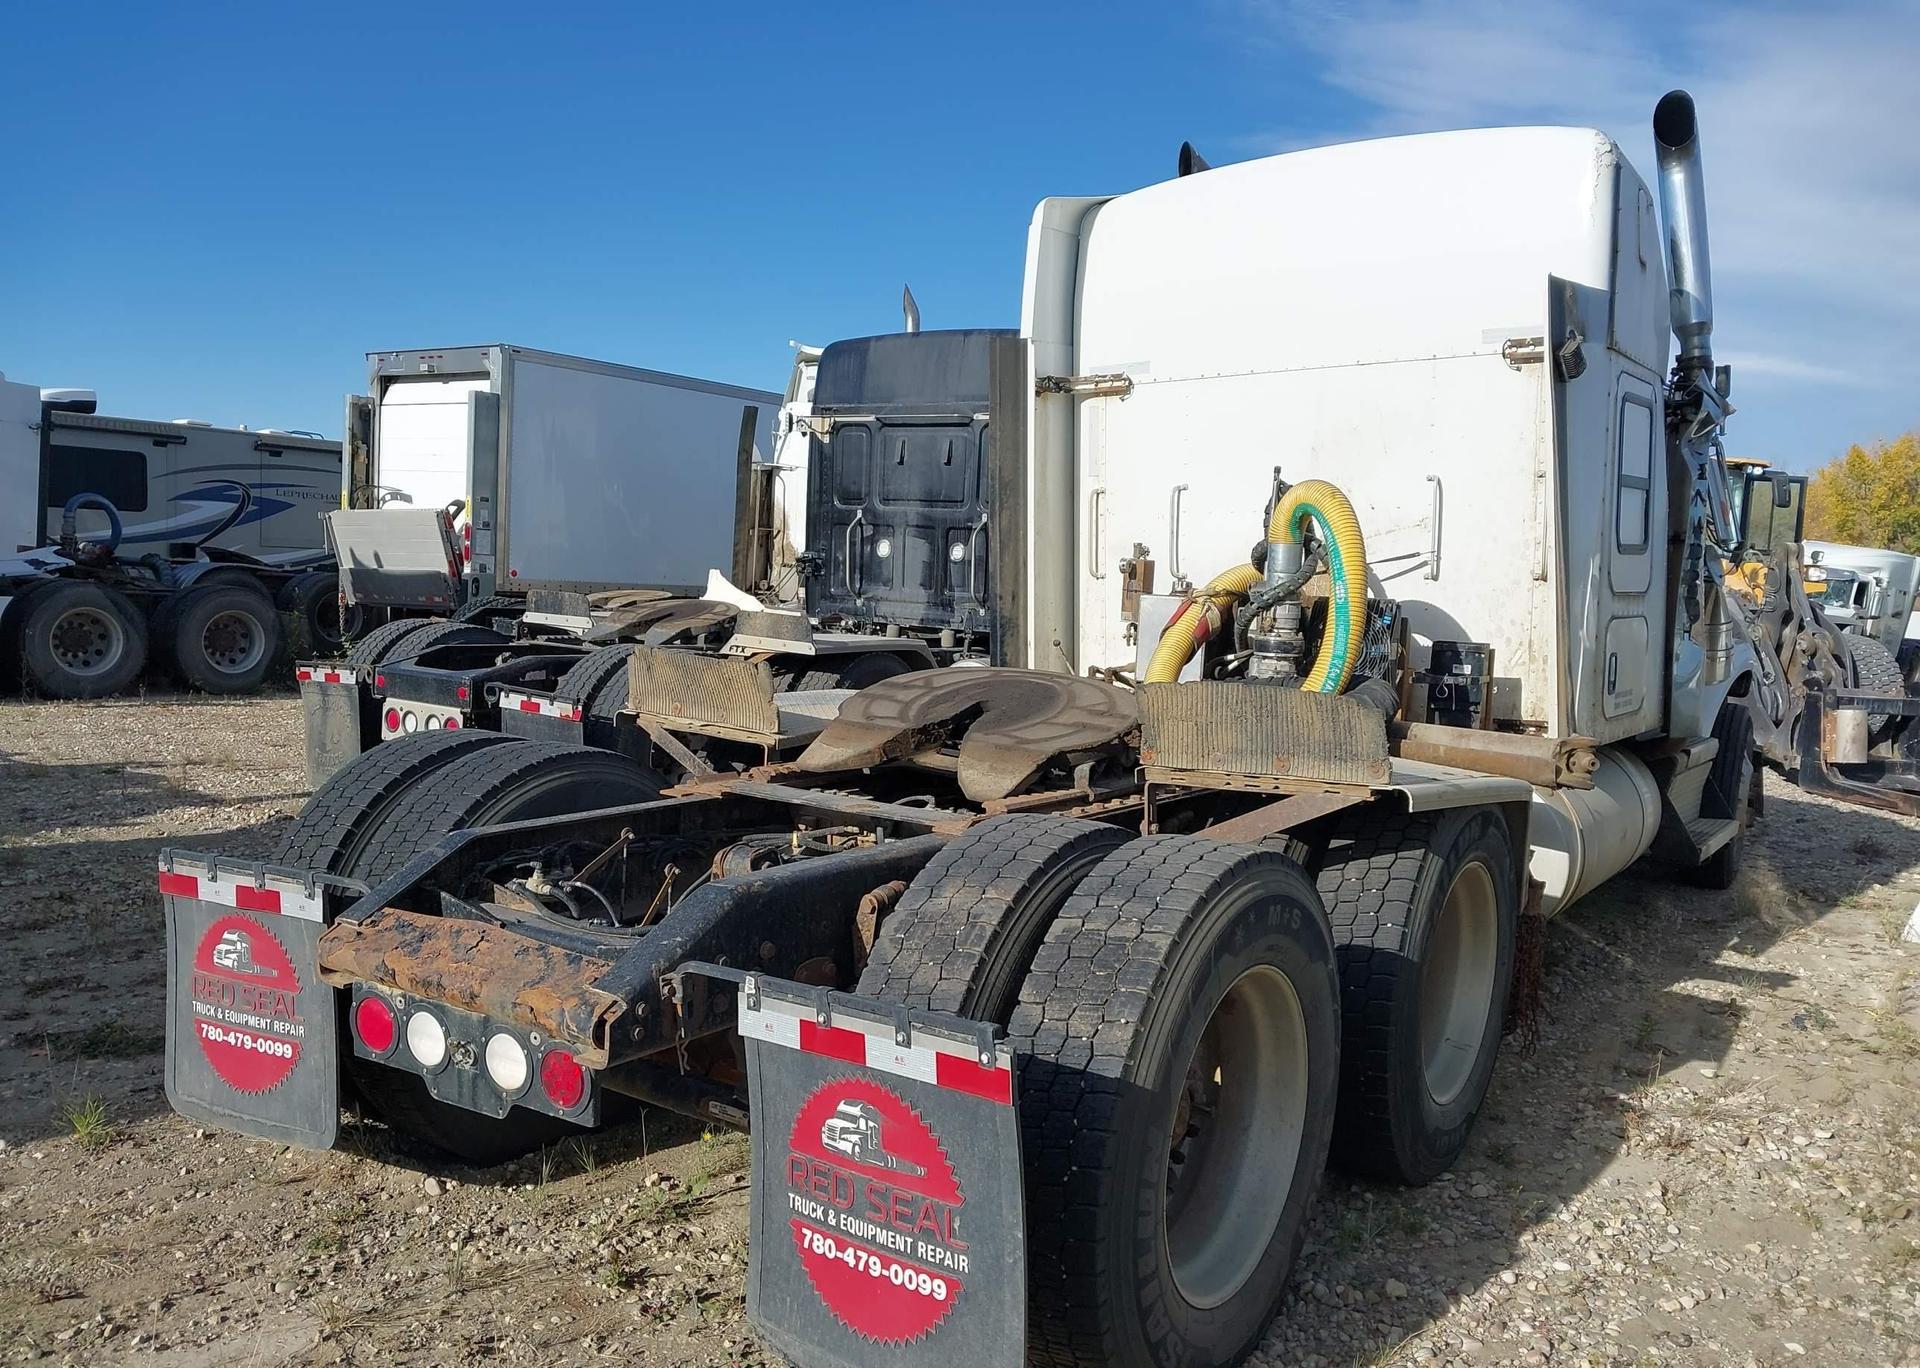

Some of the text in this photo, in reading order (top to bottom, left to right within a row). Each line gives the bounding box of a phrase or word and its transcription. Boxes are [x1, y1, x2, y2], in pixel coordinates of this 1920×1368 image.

[728, 645, 747, 654] FTX
[192, 975, 305, 1022] RED SEAL
[192, 1000, 305, 1038] TRUCK & EQUIPMENT REPAIR
[200, 1023, 293, 1059] 780-479-0099
[787, 1153, 969, 1250] RED SEAL
[788, 1192, 969, 1274] TRUCK & EQUIPMENT REPAIR
[801, 1227, 947, 1301] 780-479-0099
